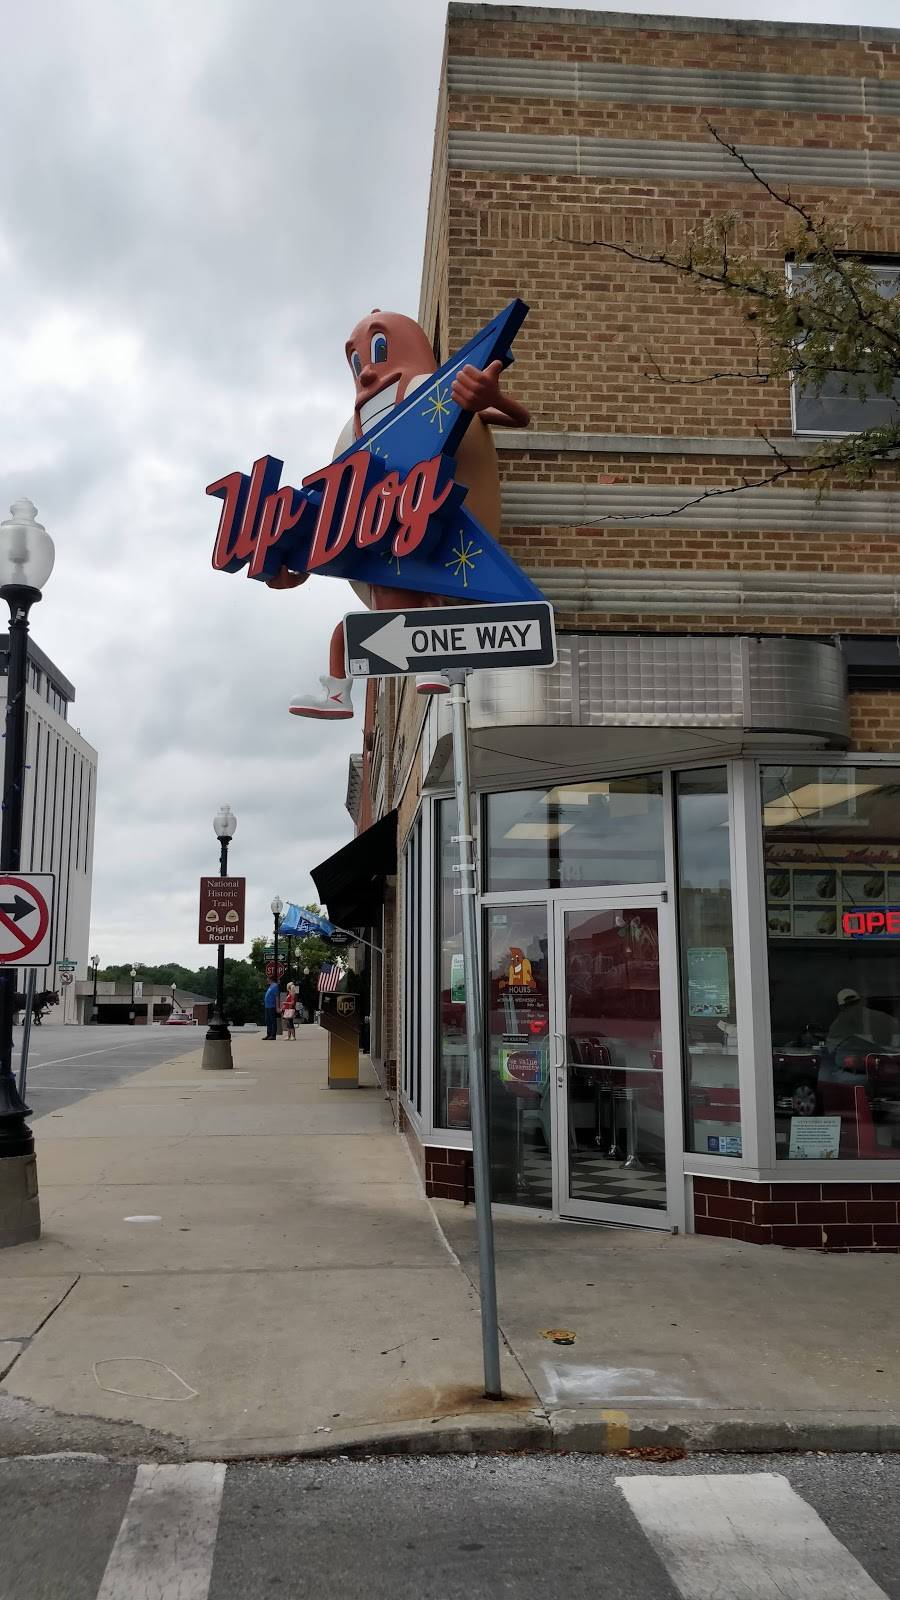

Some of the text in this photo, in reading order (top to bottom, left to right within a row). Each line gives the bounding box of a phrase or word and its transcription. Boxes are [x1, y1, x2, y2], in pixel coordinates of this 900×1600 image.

[205, 449, 456, 579] Up Dog
[411, 623, 532, 653] ONE WAY
[207, 880, 239, 888] National
[211, 899, 234, 907] Trails
[205, 925, 238, 934] Original
[267, 966, 283, 975] STP
[509, 986, 531, 994] HOURS
